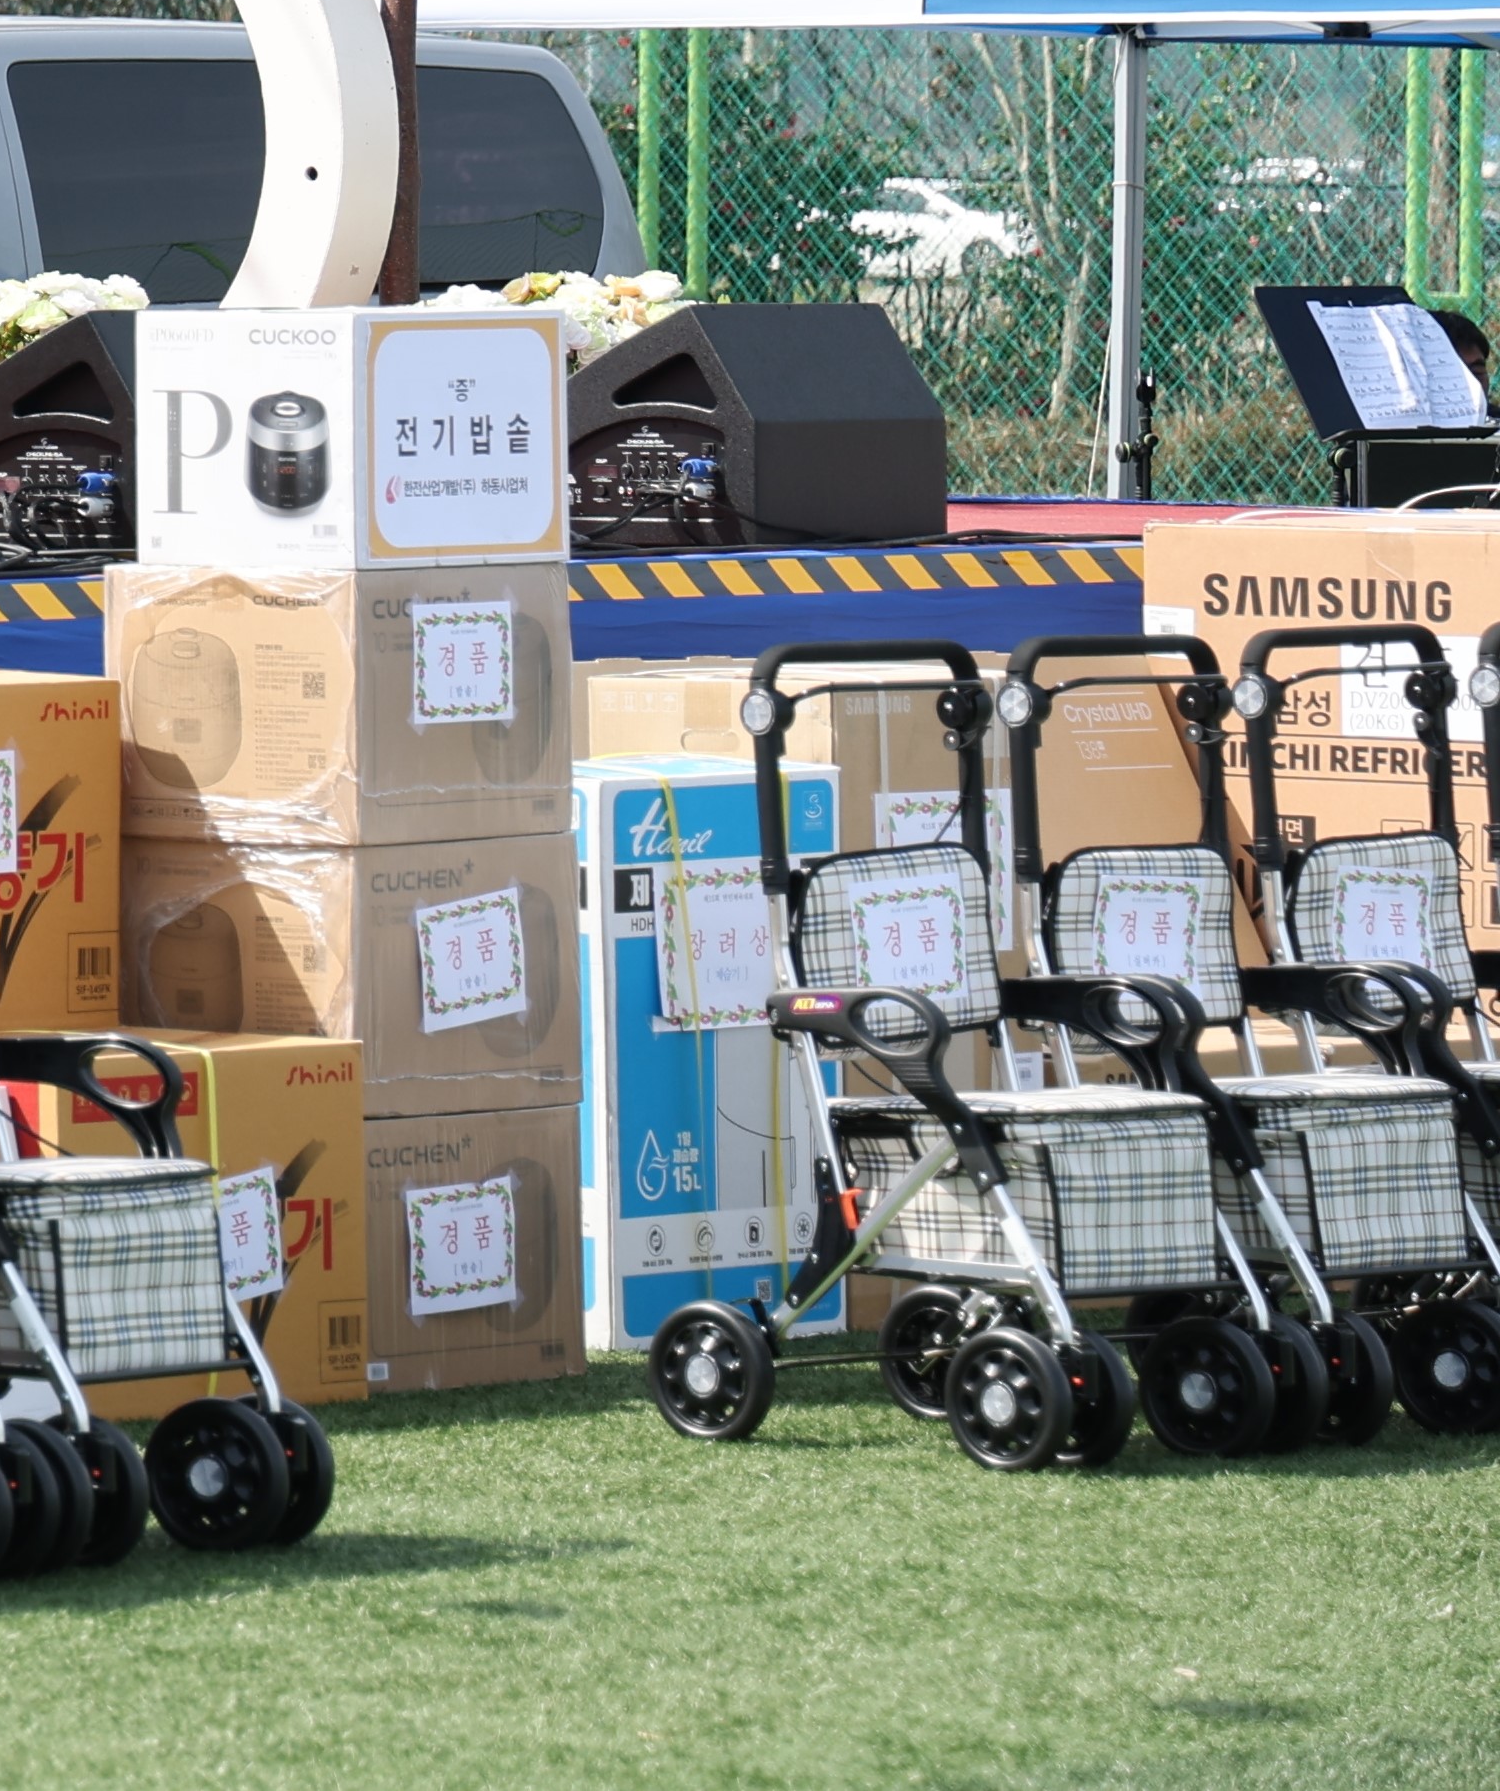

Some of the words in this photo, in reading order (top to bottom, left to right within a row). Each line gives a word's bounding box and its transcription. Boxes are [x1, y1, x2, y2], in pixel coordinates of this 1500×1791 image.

[249, 329, 337, 345] CUCKOO
[152, 389, 233, 515] P
[403, 477, 476, 498] 한전산업개발(주)
[481, 476, 529, 496] 하동사업처
[1203, 572, 1453, 623] SAMSUNG
[1063, 704, 1122, 727] Crystal
[1122, 702, 1153, 721] UHD
[1219, 740, 1321, 771] KICHI
[371, 869, 463, 893] CUCHEN
[368, 1143, 461, 1169] CUCHEN
[673, 1166, 702, 1193] 15L
